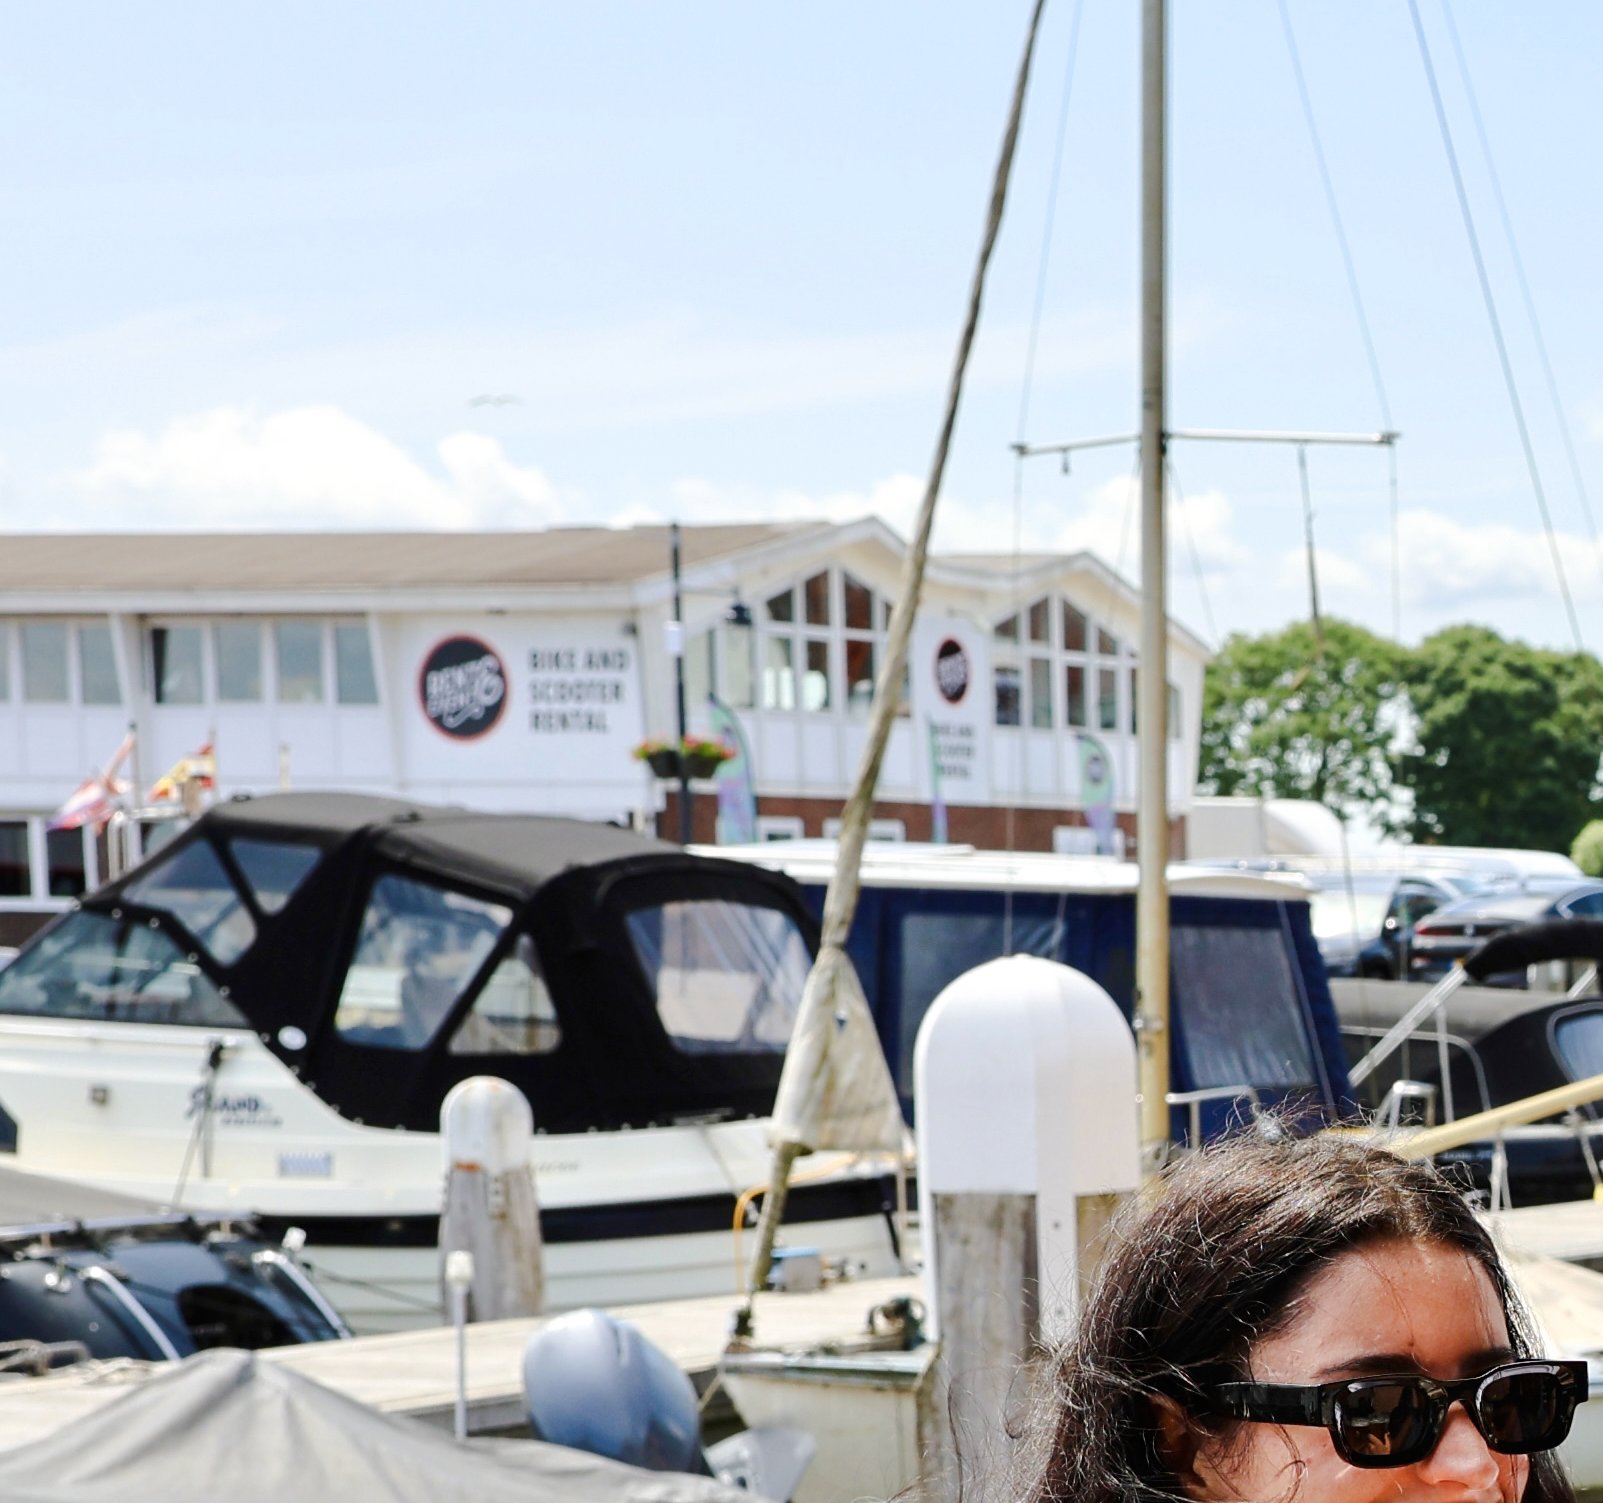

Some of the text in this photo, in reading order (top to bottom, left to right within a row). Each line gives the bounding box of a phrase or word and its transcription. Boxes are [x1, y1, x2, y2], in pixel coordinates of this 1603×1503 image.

[530, 649, 630, 673] BIKE AND
[530, 679, 626, 704] SCOOTER
[530, 710, 609, 734] RENTAL
